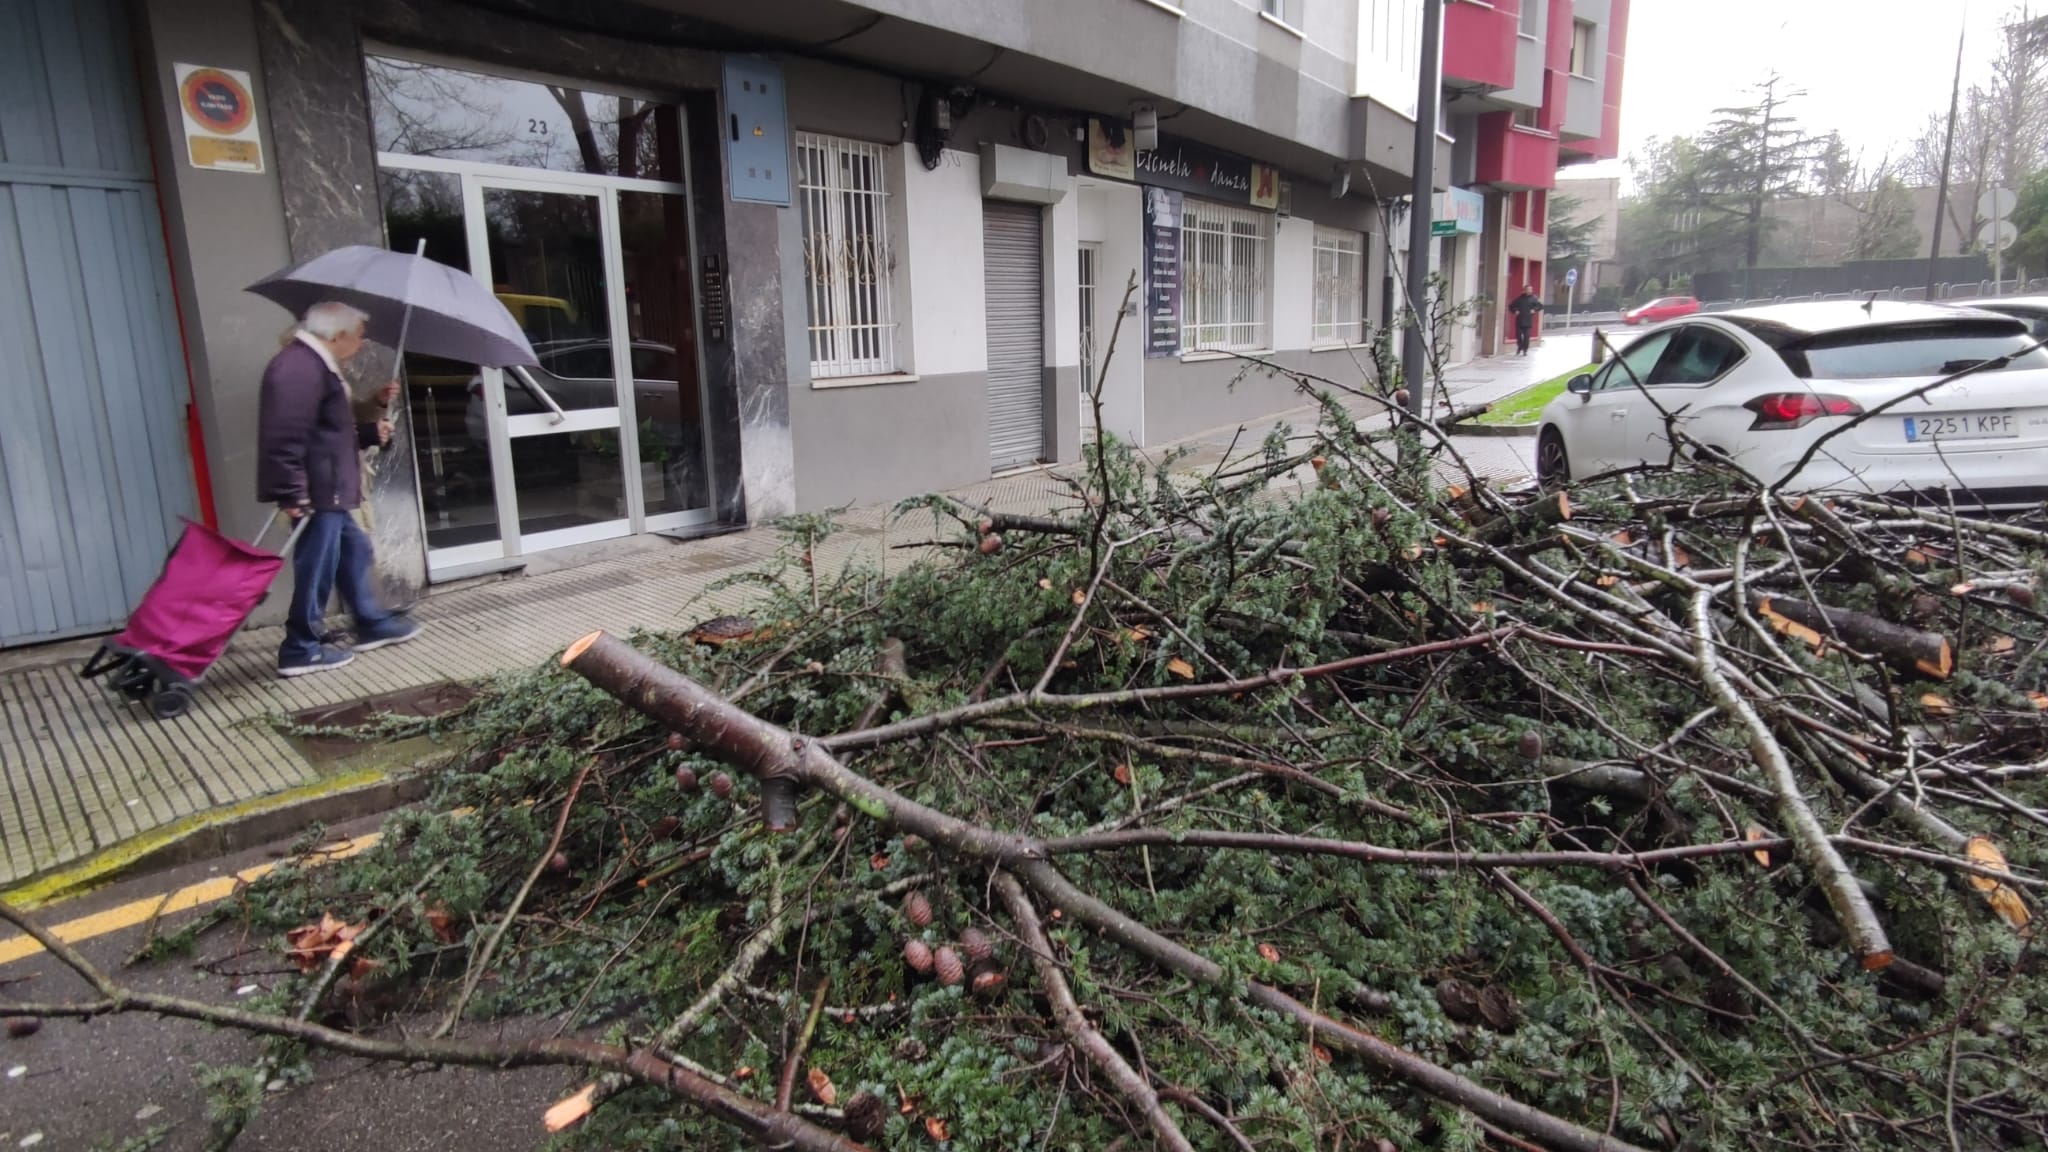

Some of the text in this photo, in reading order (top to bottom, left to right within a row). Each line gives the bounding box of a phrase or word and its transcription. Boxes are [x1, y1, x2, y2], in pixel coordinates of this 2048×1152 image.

[528, 119, 548, 135] 23
[1136, 147, 1191, 177] Escuela
[1210, 162, 1248, 190] danza
[1920, 415, 2012, 435] 2251 KPF
